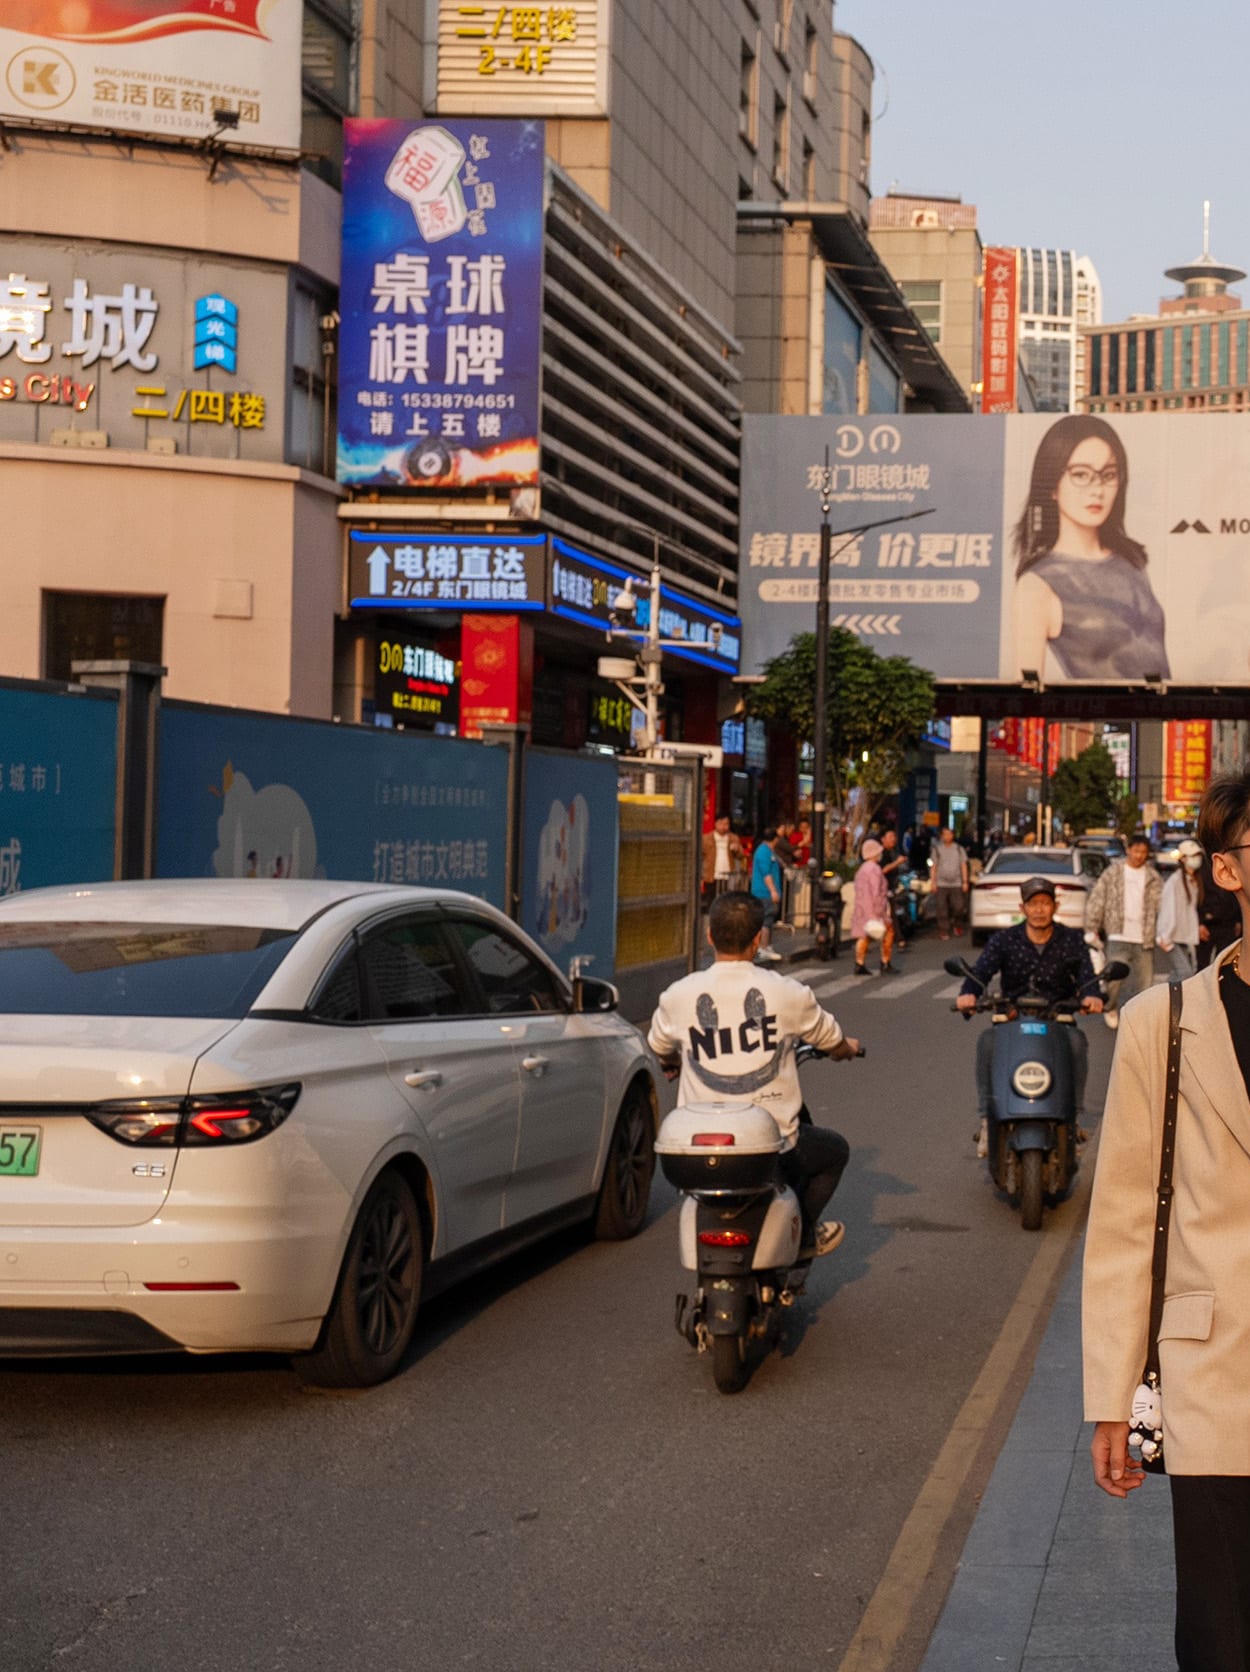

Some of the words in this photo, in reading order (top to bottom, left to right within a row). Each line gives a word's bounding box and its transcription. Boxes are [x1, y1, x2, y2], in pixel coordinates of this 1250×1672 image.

[456, 7, 577, 42] 二/四楼
[478, 45, 552, 75] 2-4F
[371, 253, 506, 315] 桌球
[369, 322, 505, 386] 棋牌
[24, 371, 95, 412] City
[131, 386, 265, 429] 二/四楼
[370, 411, 501, 438] 请上五楼
[806, 463, 931, 491] 东门眼镜城
[393, 545, 526, 581] 电梯直达
[749, 533, 865, 568] 镜界高
[876, 533, 994, 568] 价更低
[391, 580, 434, 597] 2/4F
[437, 580, 528, 601] 东门眼镜城
[688, 1014, 778, 1060] NICE
